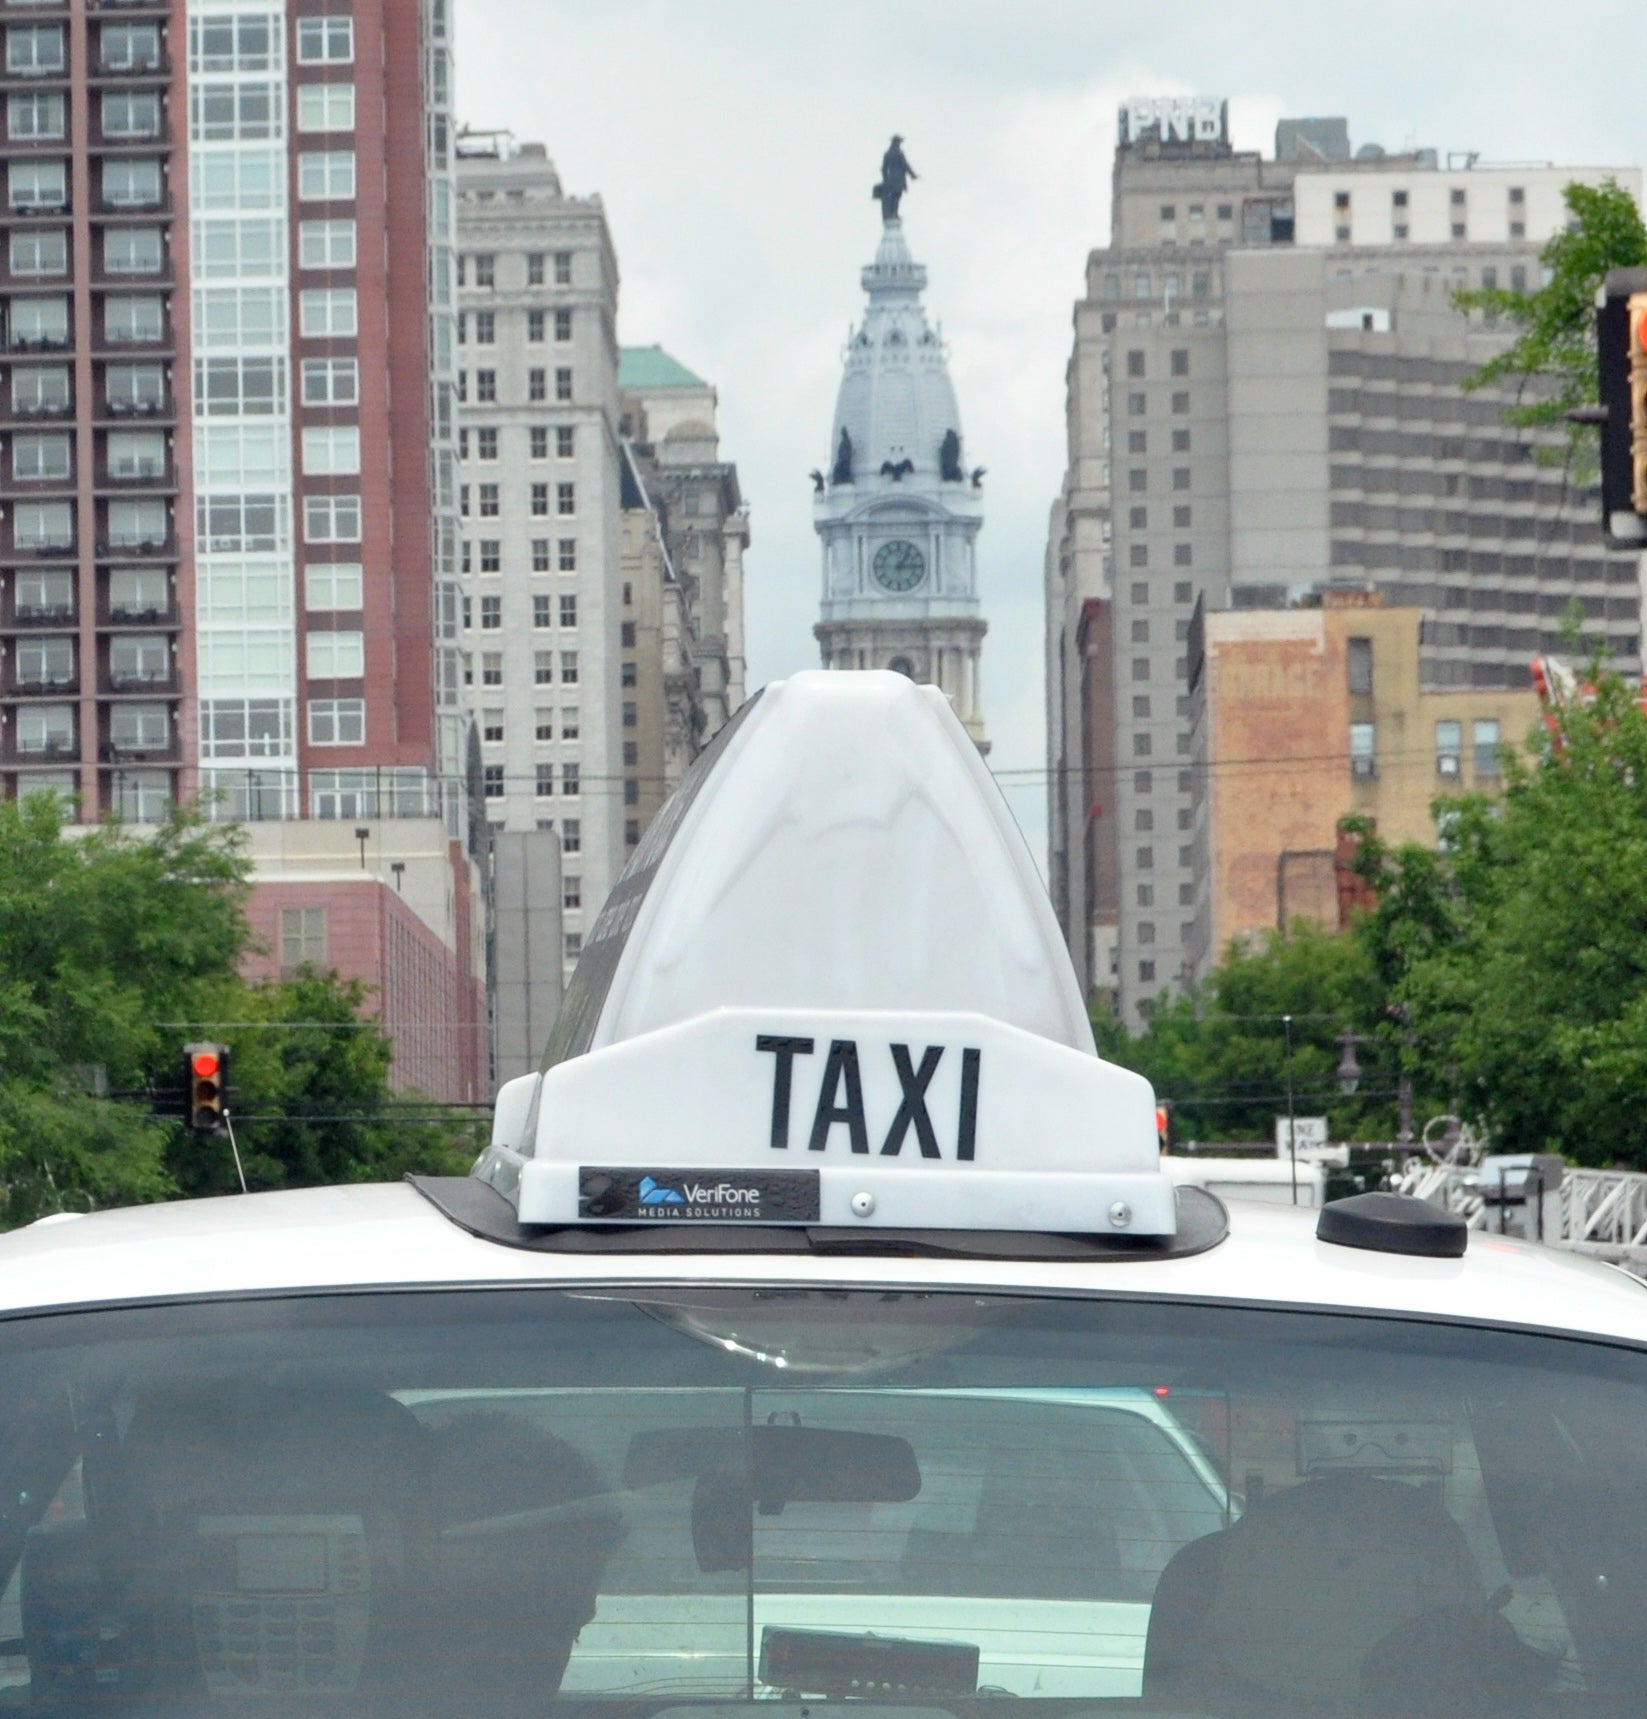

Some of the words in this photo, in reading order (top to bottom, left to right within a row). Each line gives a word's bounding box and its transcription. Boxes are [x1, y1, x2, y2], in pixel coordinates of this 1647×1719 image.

[1127, 97, 1223, 143] PNB
[755, 1034, 981, 1162] TAXI
[684, 1183, 760, 1204] VeriFone
[638, 1207, 680, 1217] MEDIA
[686, 1207, 761, 1218] SOLUTIONS
